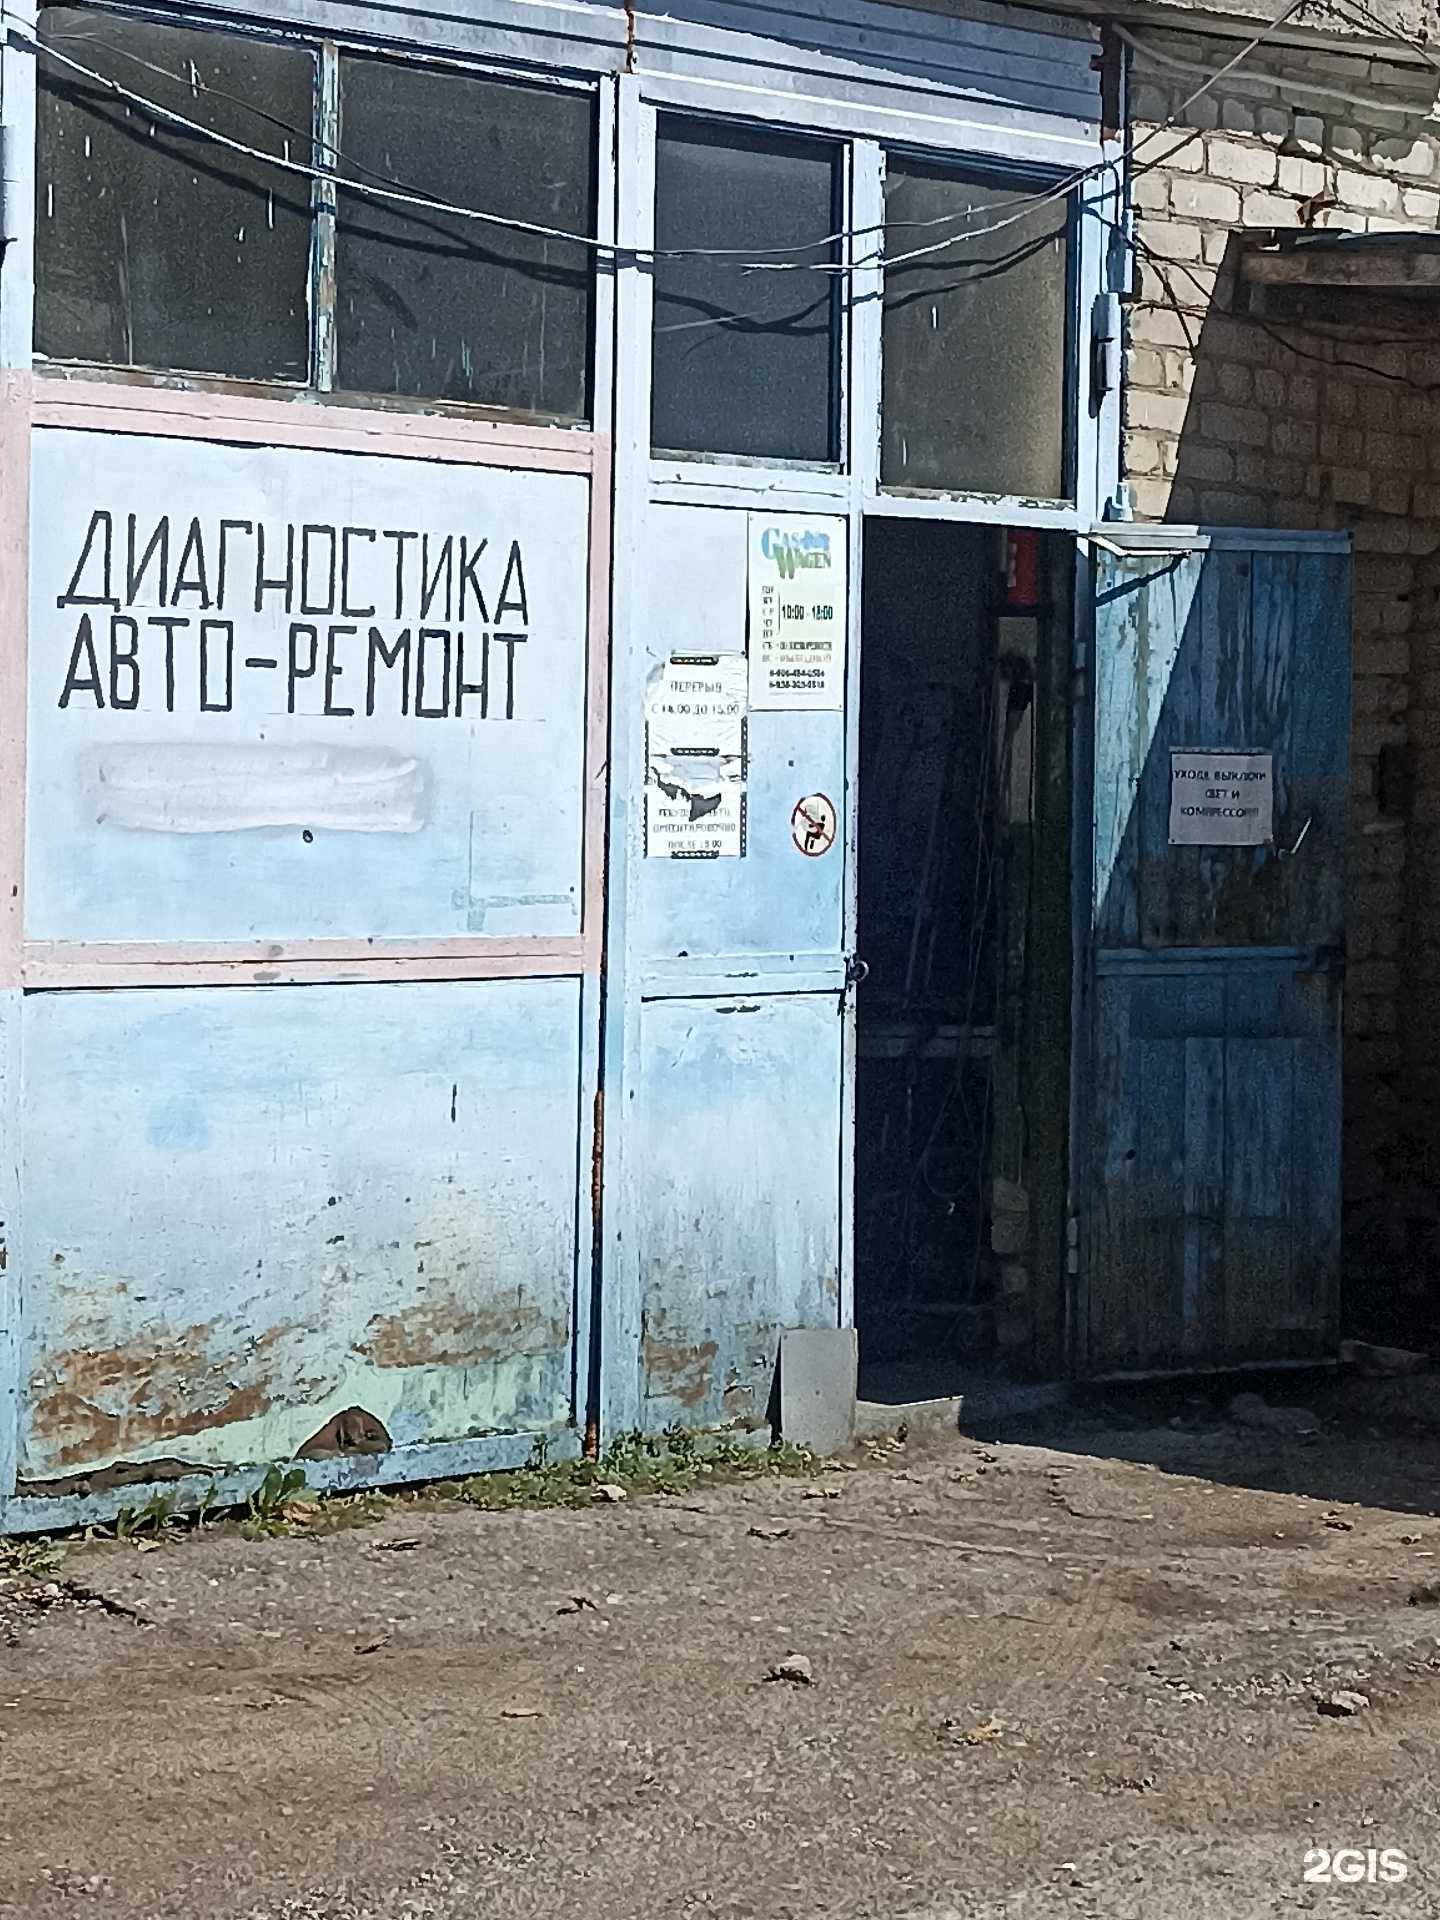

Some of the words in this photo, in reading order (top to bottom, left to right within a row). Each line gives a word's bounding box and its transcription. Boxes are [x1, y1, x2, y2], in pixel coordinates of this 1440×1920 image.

[57, 510, 529, 625] ДИАГНОСТИКА
[782, 604, 804, 619] 10:00
[812, 605, 833, 620] 18:00
[58, 613, 528, 720] АВТО-РЕМОНТ
[670, 680, 722, 693] ПЕРЕРЫВ
[1231, 790, 1240, 799] И
